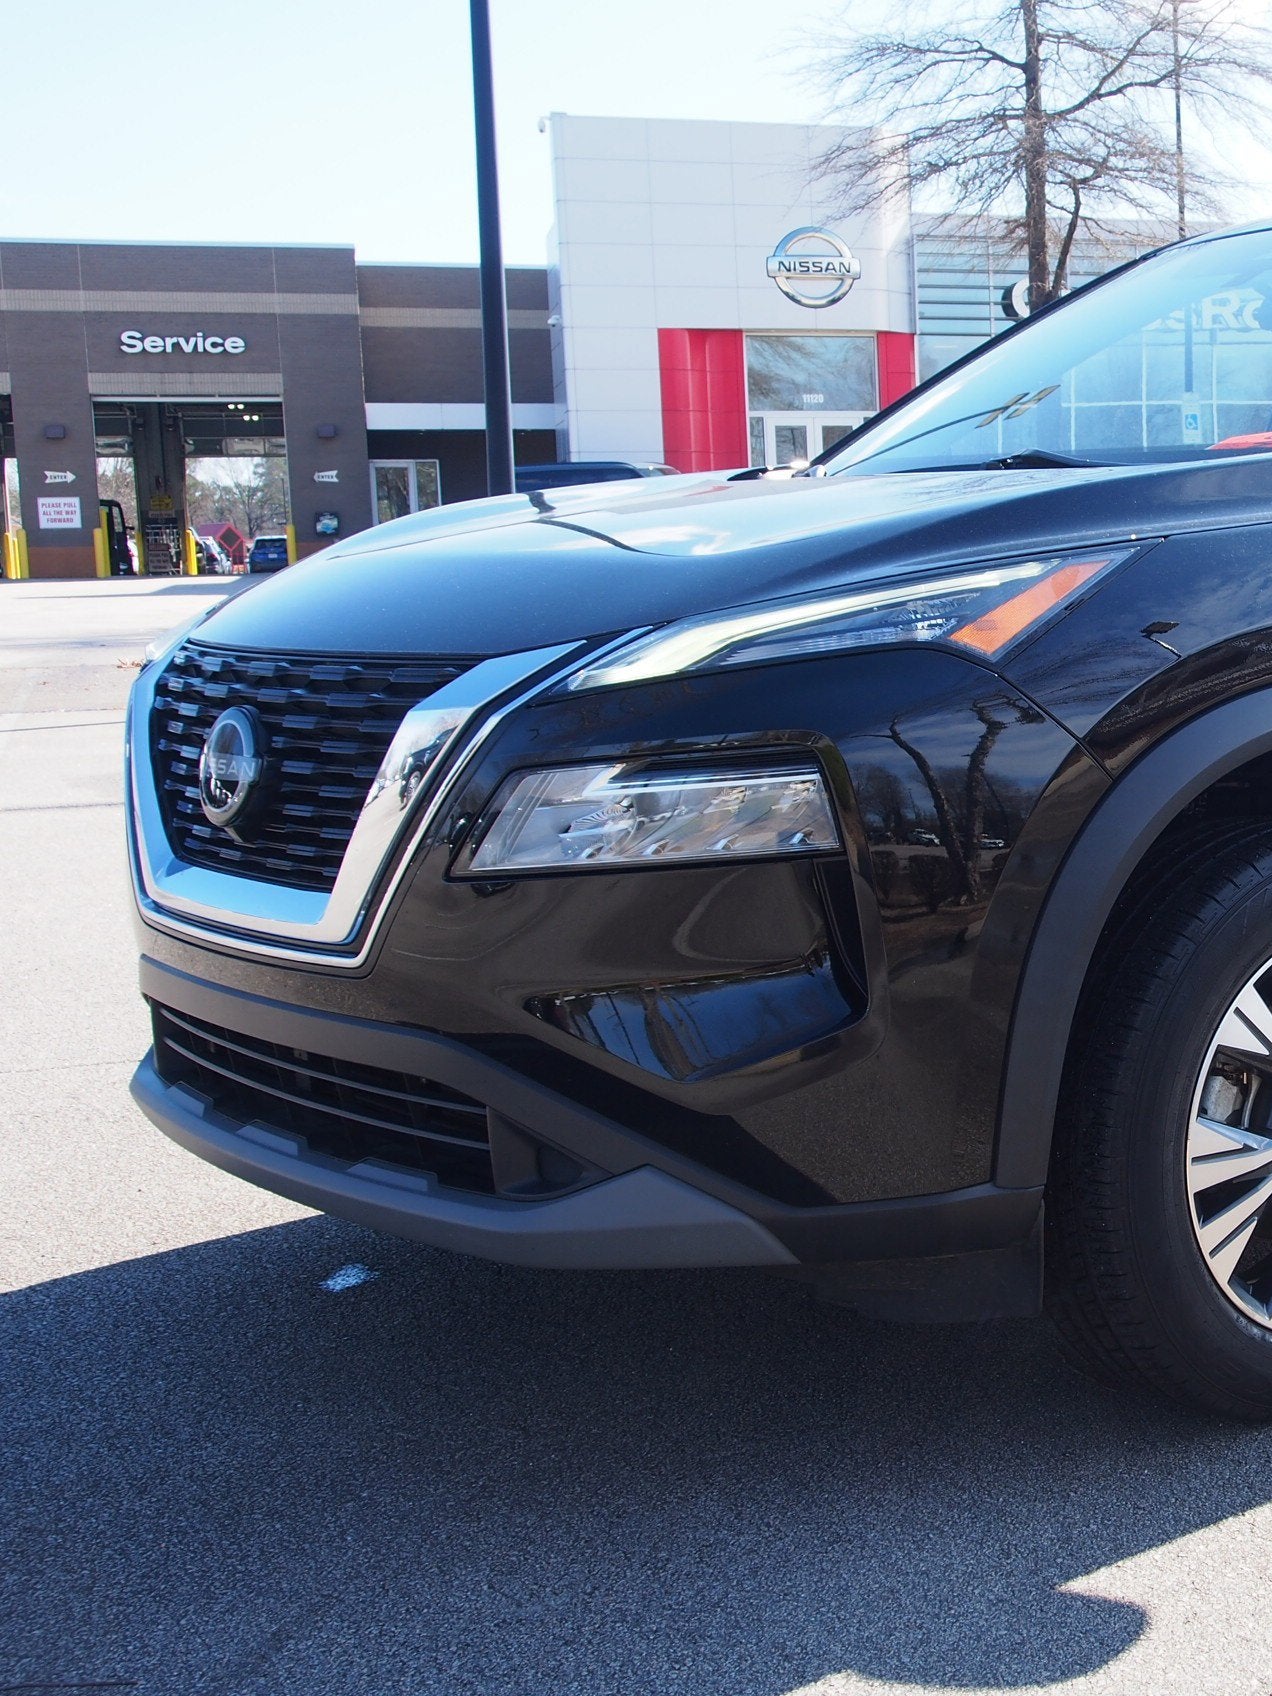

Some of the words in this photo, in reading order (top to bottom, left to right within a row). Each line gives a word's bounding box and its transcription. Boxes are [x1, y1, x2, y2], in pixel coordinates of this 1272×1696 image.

[778, 260, 851, 273] NISSAN
[120, 330, 246, 354] Service
[802, 393, 824, 403] 11120
